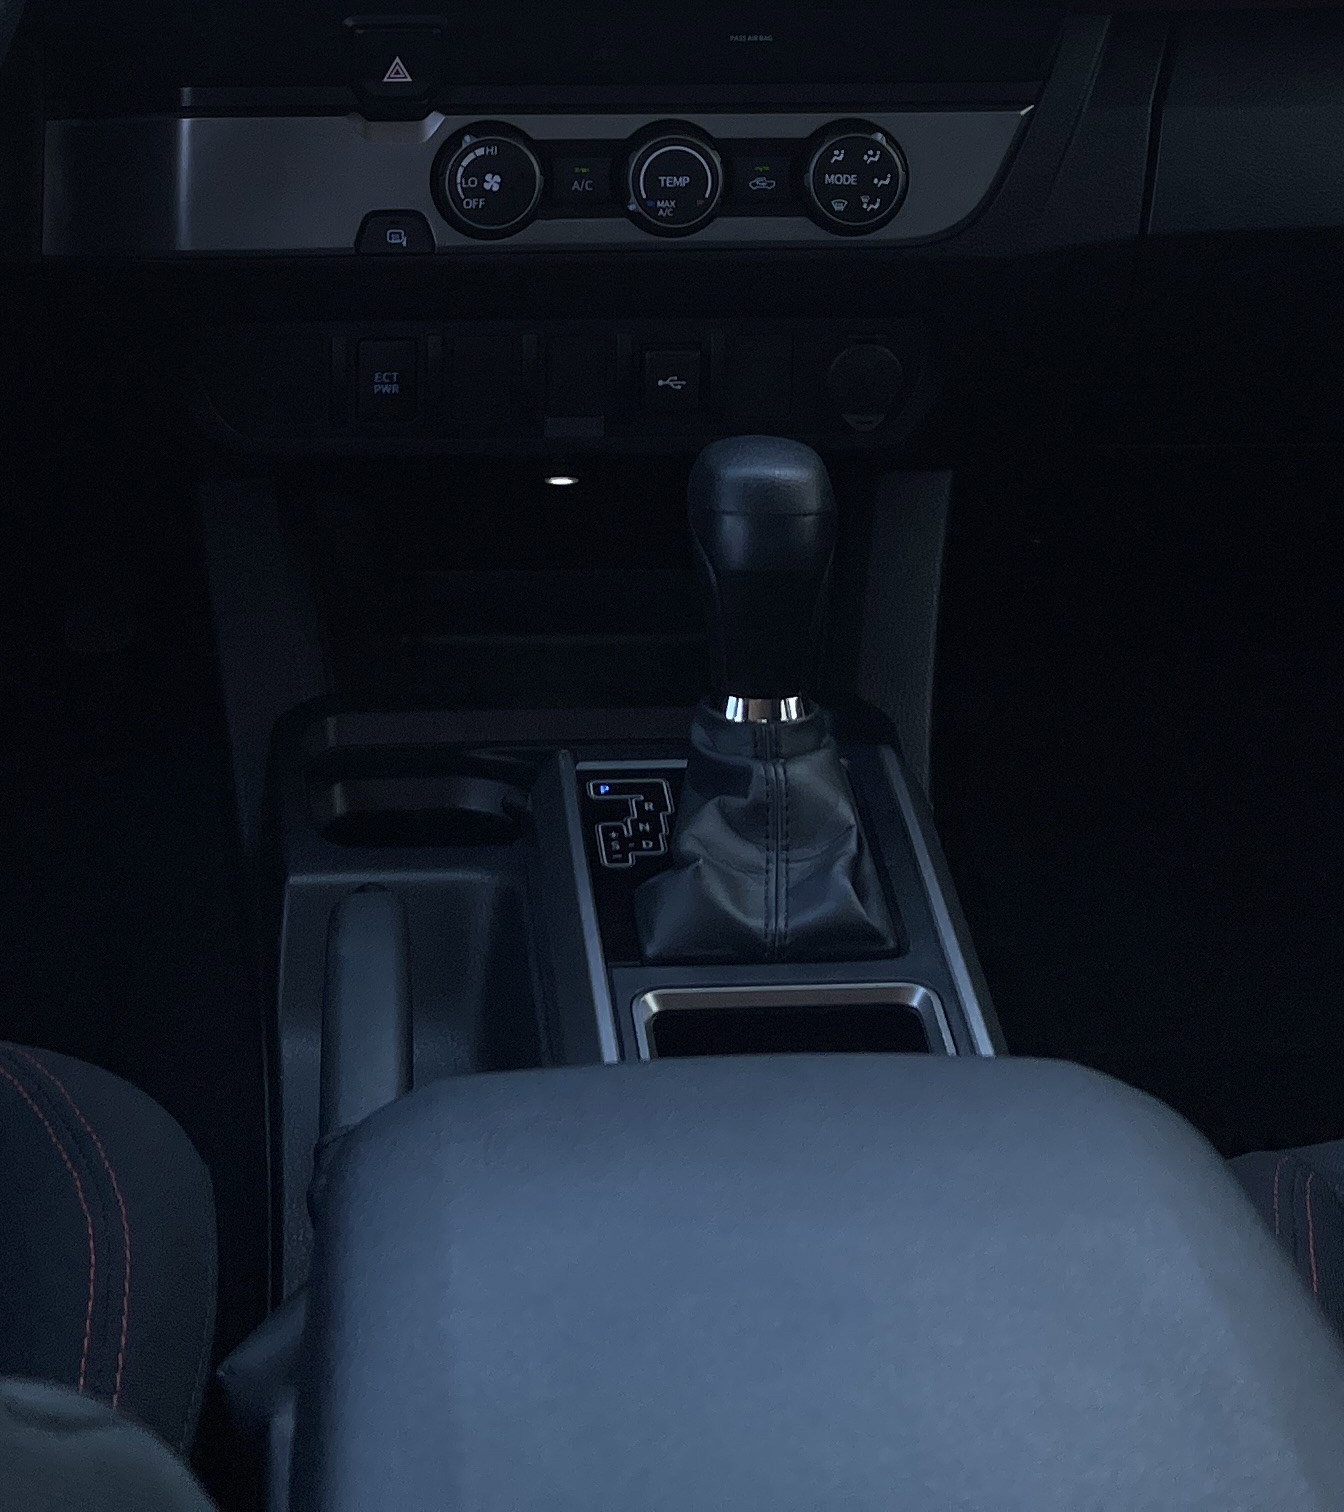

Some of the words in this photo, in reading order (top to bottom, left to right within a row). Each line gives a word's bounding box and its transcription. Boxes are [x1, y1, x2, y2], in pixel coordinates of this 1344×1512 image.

[485, 145, 498, 156] HI
[462, 177, 478, 188] LO
[572, 180, 594, 191] A/C
[658, 175, 691, 188] TEMP
[824, 174, 858, 186] MODE
[462, 198, 487, 210] OFF
[657, 199, 676, 209] MAX
[644, 801, 655, 811] R
[638, 822, 650, 833] N
[641, 840, 653, 849] D
